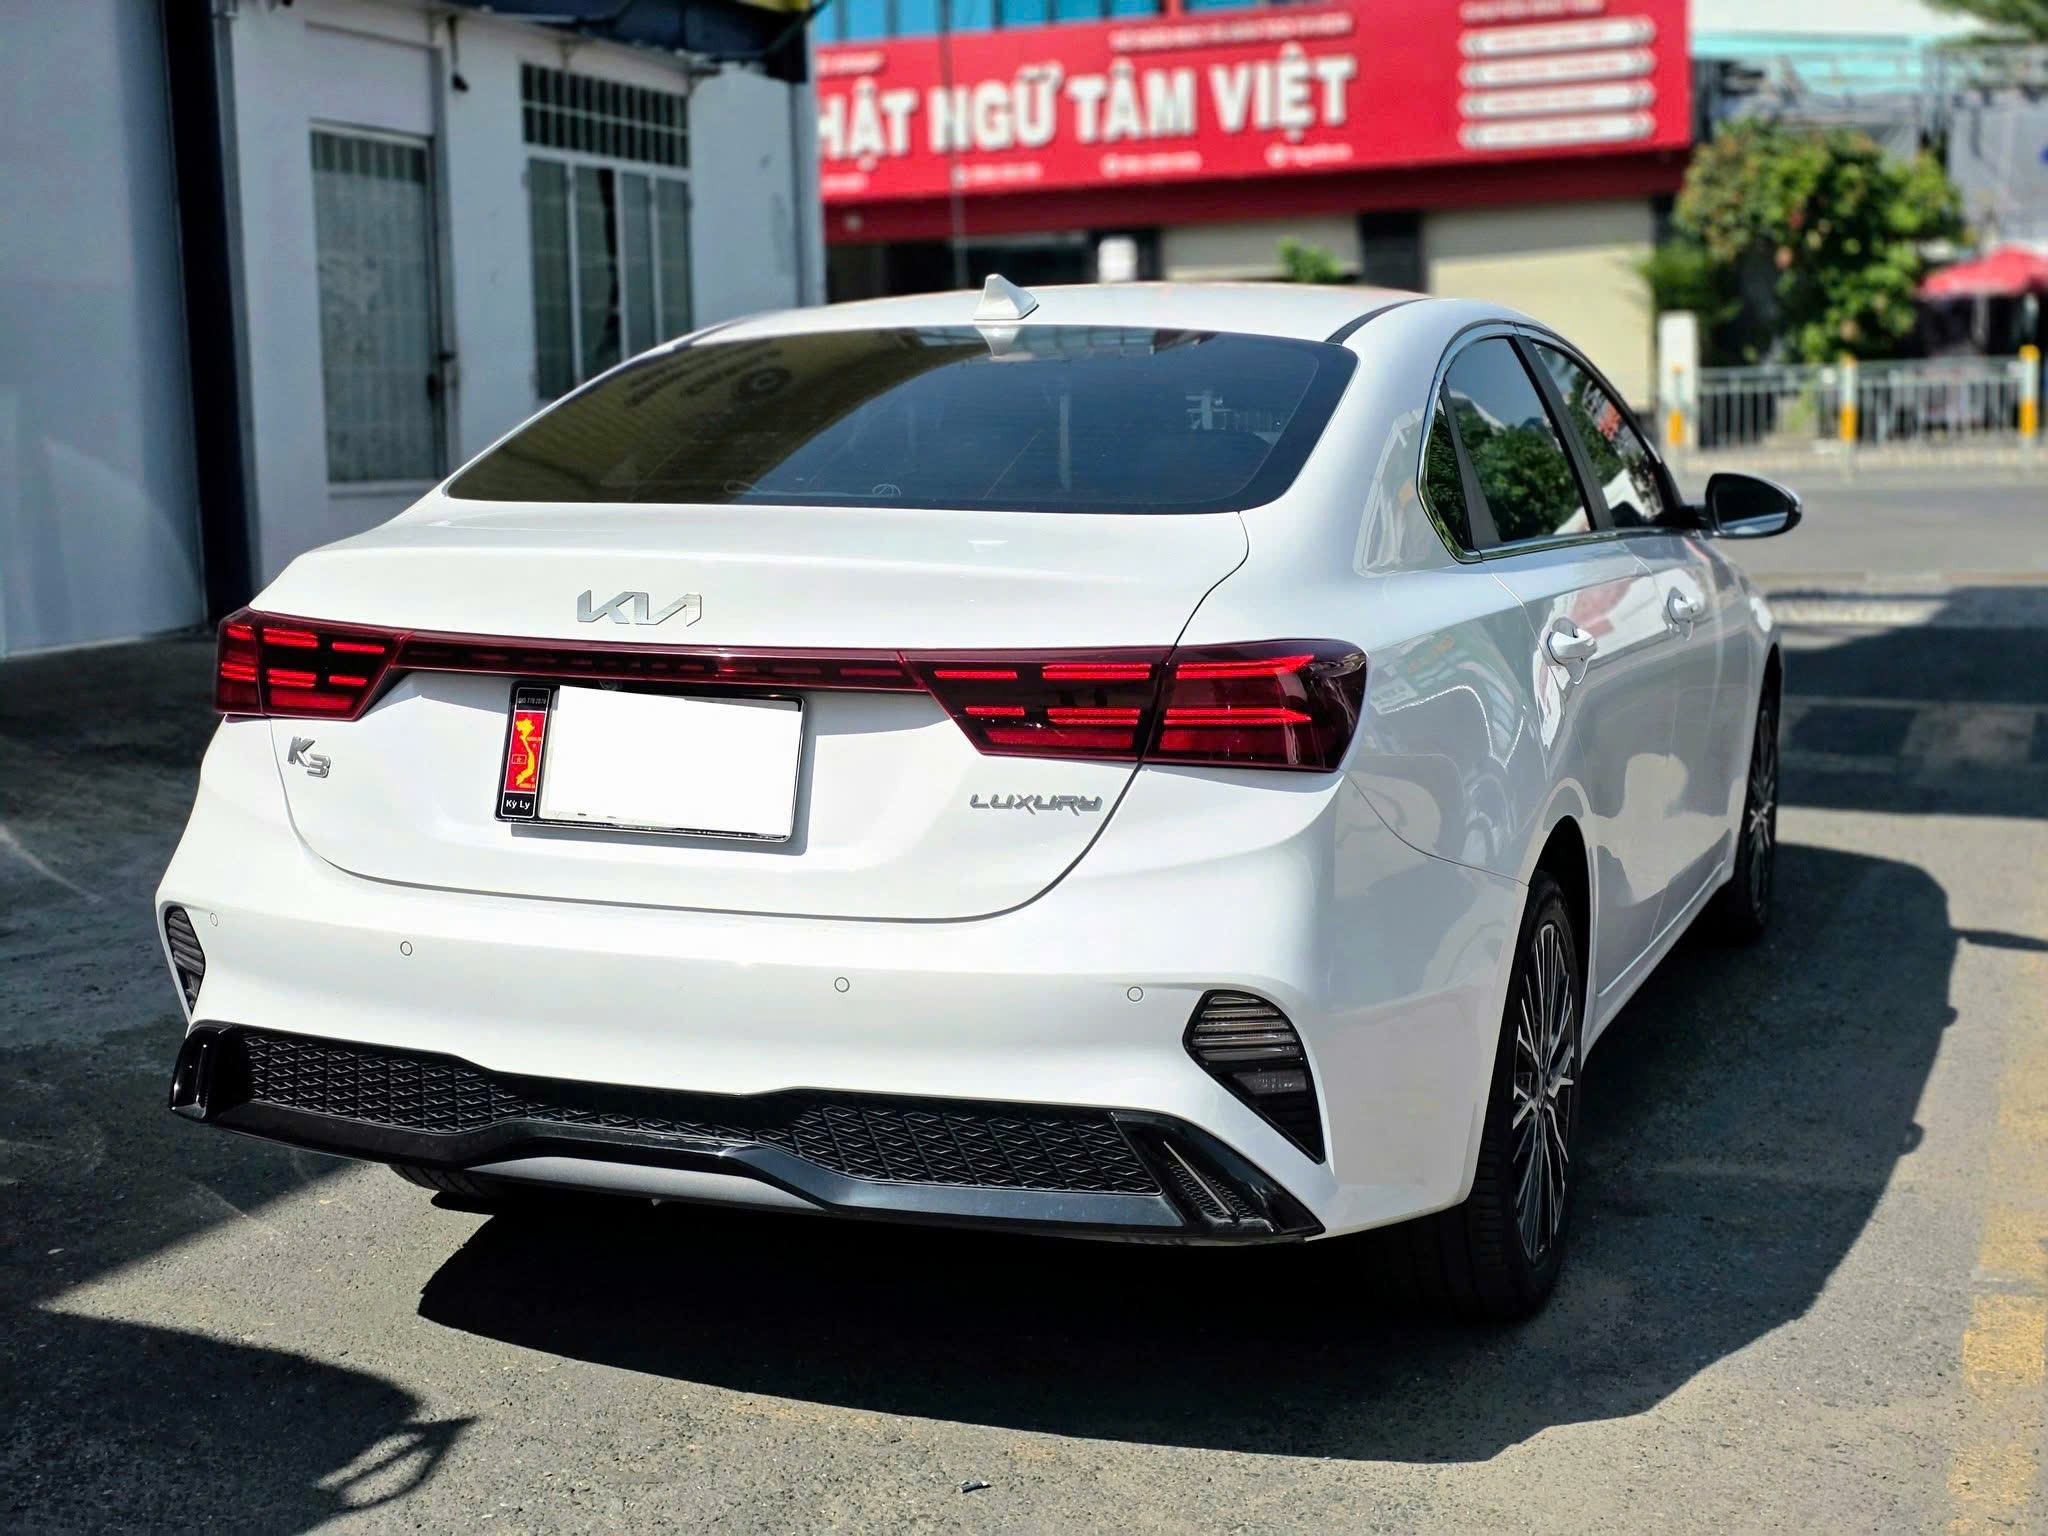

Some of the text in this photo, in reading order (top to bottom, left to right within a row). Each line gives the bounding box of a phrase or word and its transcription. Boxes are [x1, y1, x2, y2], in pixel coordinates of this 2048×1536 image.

[928, 61, 1063, 152] NGỮ
[1067, 57, 1196, 142] TÂM
[1208, 41, 1355, 141] VIỆT
[287, 736, 331, 778] K3
[969, 793, 1103, 816] LUXURY
